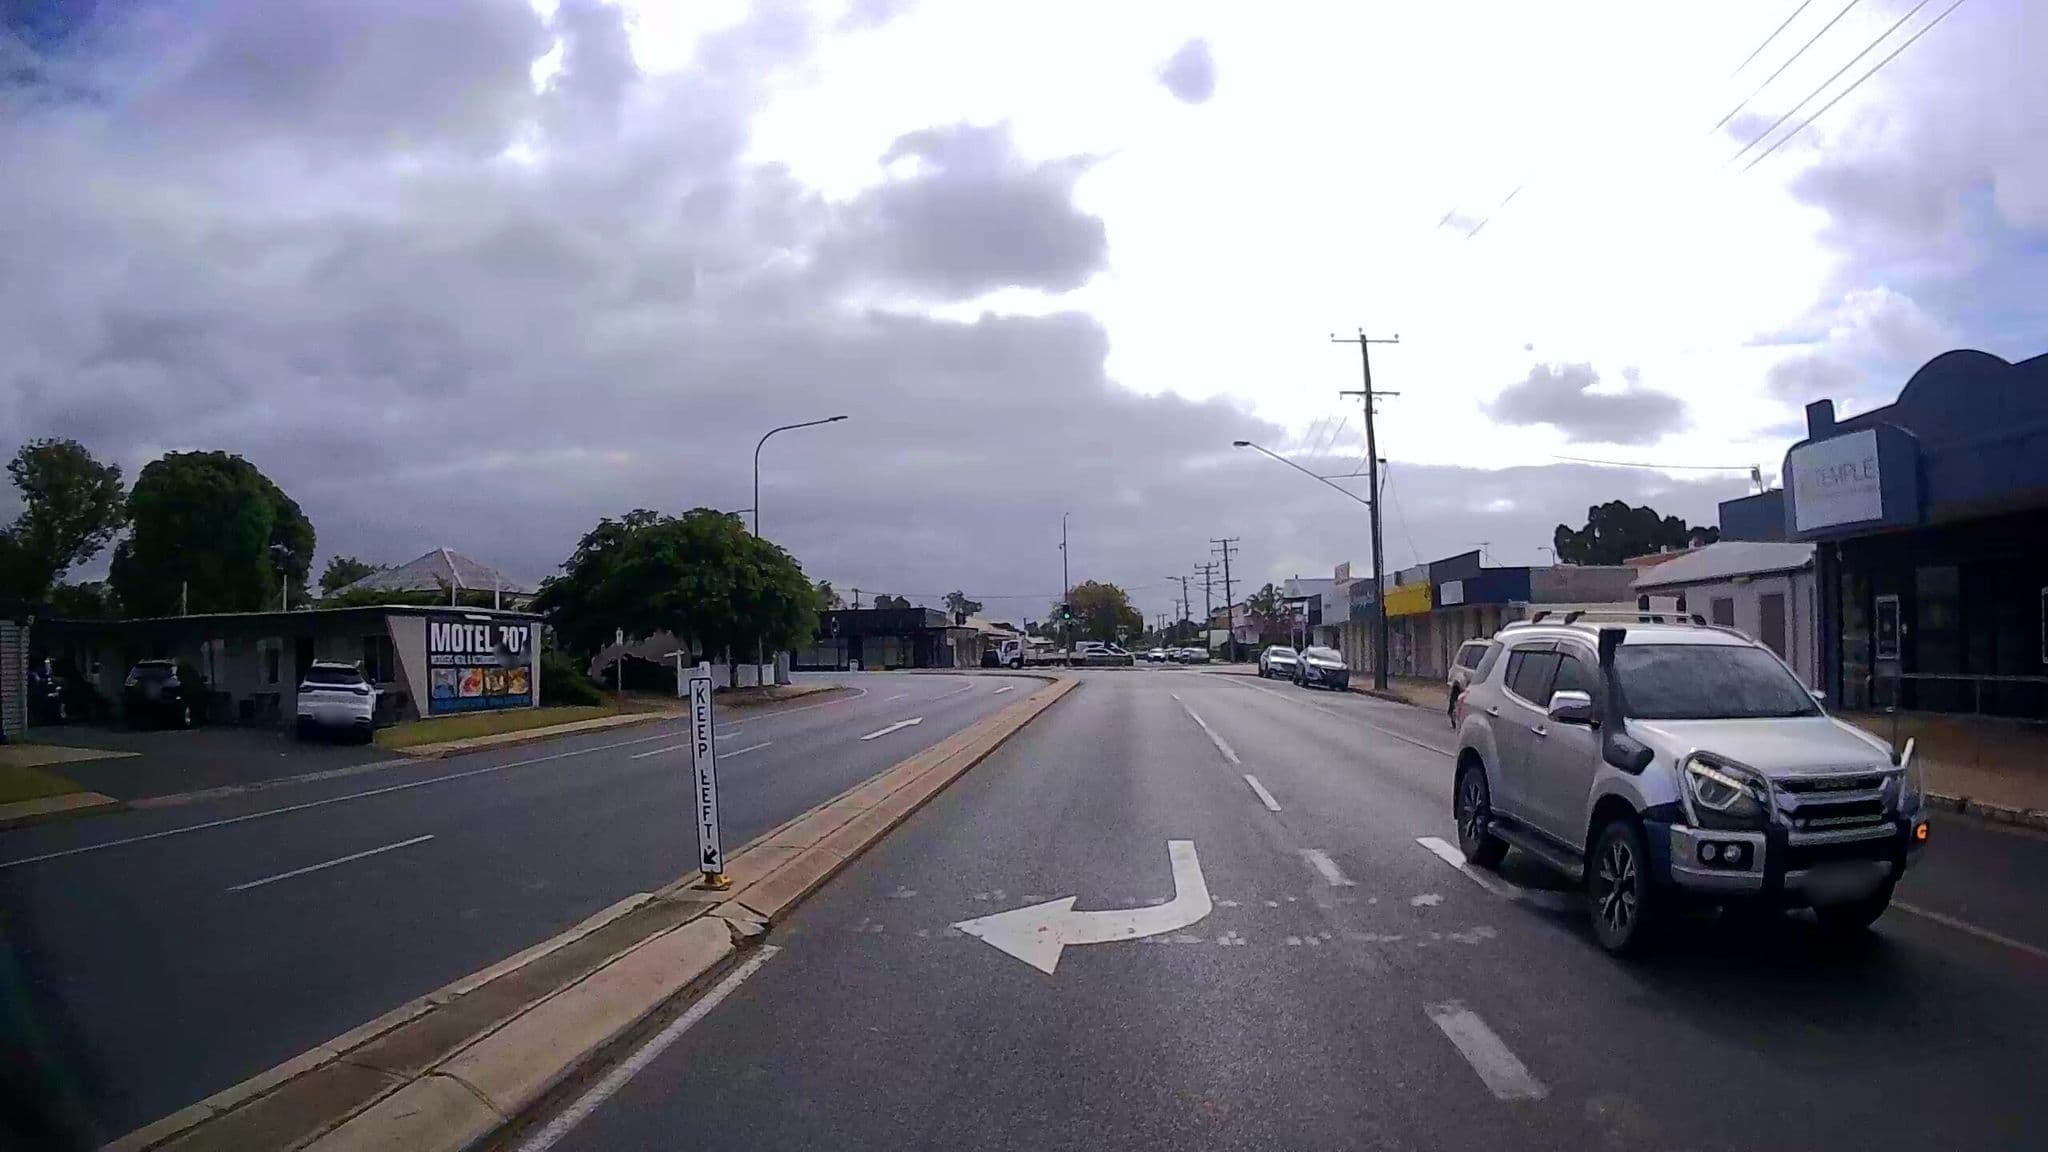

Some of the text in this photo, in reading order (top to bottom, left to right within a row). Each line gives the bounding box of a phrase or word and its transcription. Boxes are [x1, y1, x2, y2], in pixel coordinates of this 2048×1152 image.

[431, 622, 528, 652] MOTEL 707
[696, 687, 714, 840] KEEP LEFT
